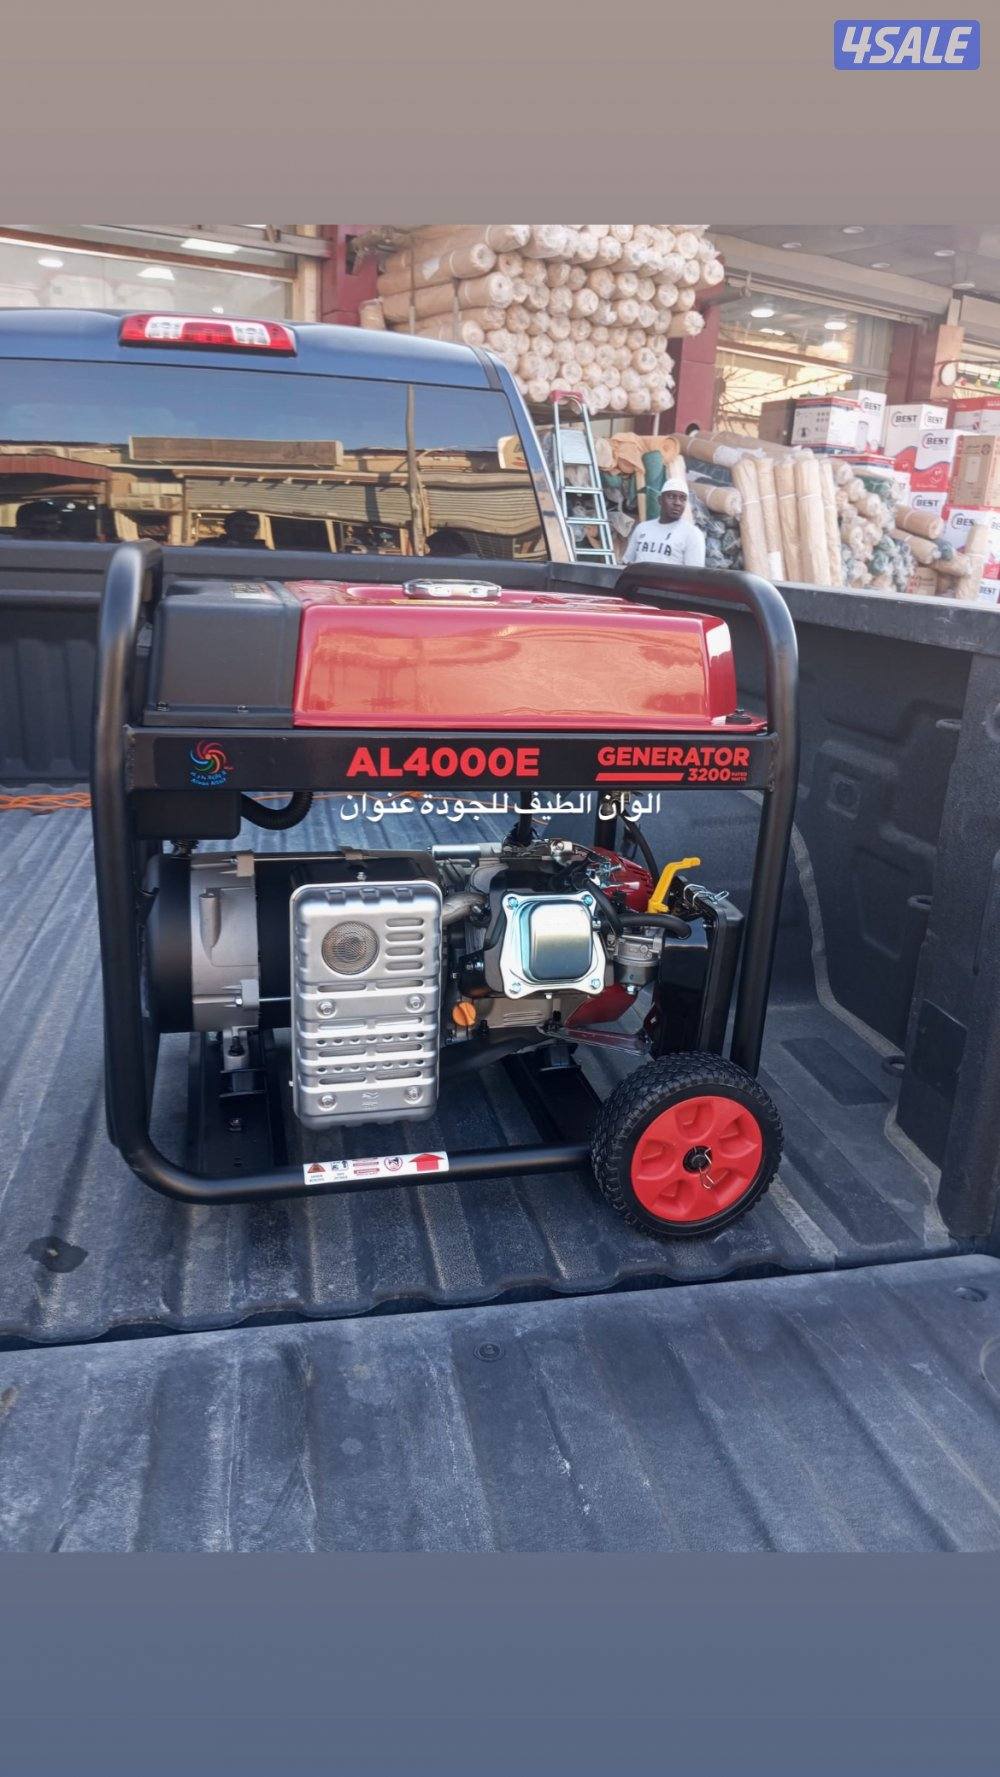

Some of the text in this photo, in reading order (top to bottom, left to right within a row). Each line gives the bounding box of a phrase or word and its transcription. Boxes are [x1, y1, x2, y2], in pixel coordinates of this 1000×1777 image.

[864, 401, 882, 411] BEST
[895, 414, 918, 423] BEST
[927, 415, 944, 424] BEST
[926, 437, 949, 445] BEST
[916, 499, 939, 507] BEST
[956, 517, 975, 526] BES
[597, 746, 750, 766] GENERATOR
[346, 747, 540, 777] AL4000E
[688, 768, 731, 781] 3200
